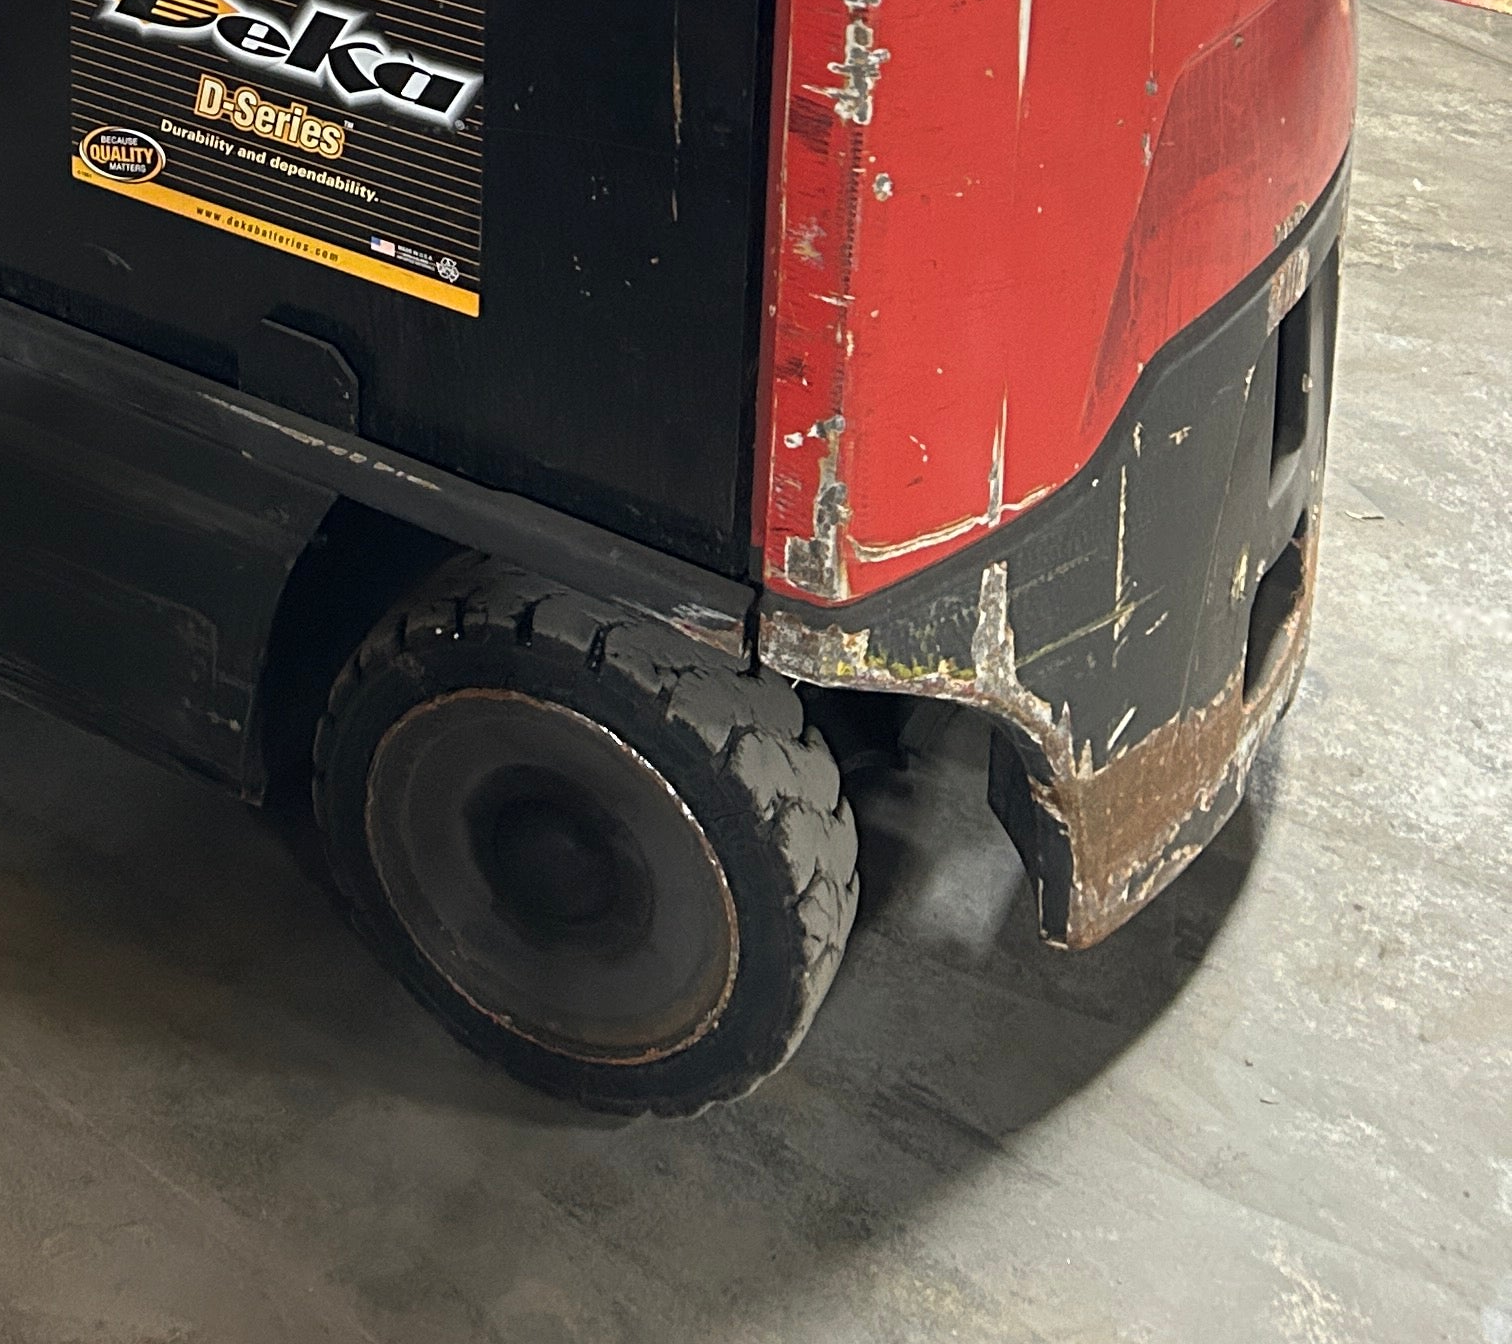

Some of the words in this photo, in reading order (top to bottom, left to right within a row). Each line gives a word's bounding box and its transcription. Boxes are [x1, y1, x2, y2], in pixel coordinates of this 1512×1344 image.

[194, 74, 345, 160] D-Series
[89, 143, 154, 164] QUALITY
[100, 135, 139, 146] BECAUSE
[109, 162, 147, 173] MATTERS
[160, 118, 235, 154] Durability
[237, 144, 266, 165] and
[269, 151, 380, 204] dependability.
[195, 206, 339, 262] www.dekabatteries.com
